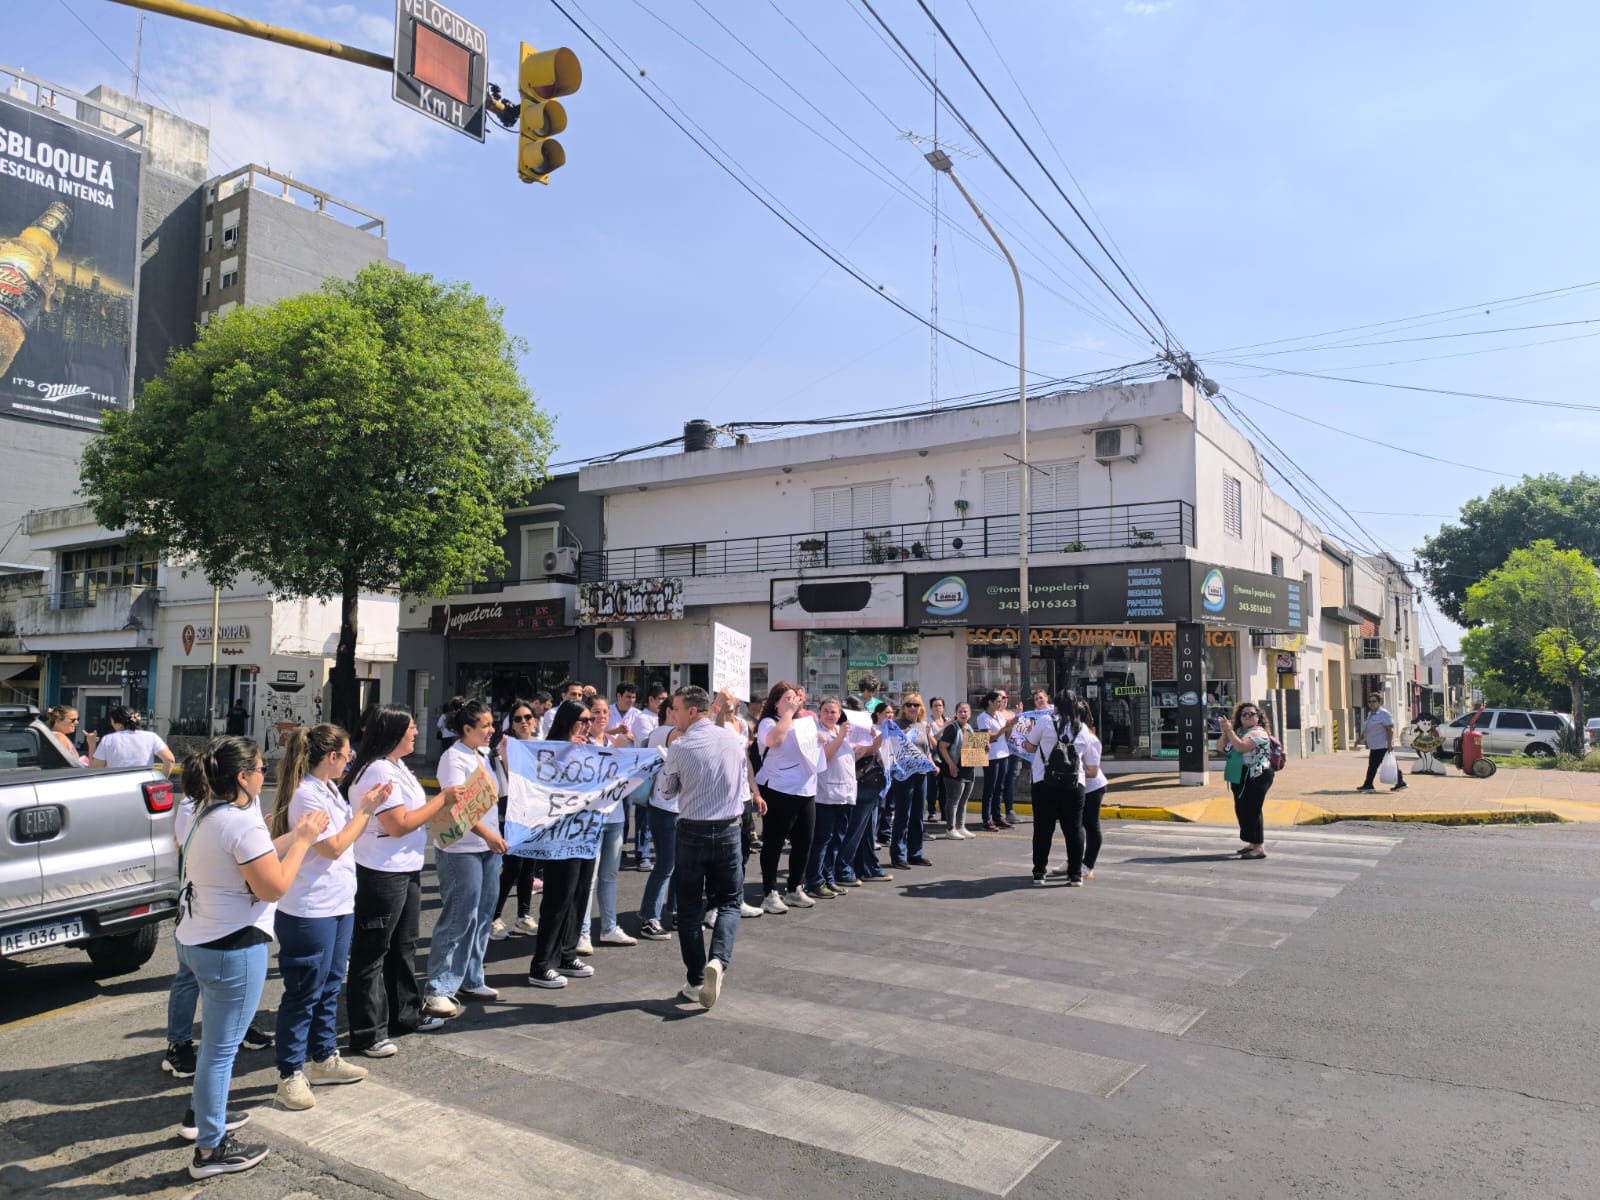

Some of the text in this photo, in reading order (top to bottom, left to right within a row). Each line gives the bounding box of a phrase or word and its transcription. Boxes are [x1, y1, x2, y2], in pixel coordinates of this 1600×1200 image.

[404, 0, 483, 54] VELOCIDAD
[58, 177, 114, 209] INTENSA
[12, 376, 35, 389] IT'S
[37, 382, 91, 402] Miller
[1128, 567, 1162, 576] SELLOS
[986, 583, 1089, 596] @tom1papeleria
[998, 599, 1077, 610] 3435016363
[196, 623, 249, 640] SERNDIPIA
[1117, 686, 1145, 695] ABIERTO
[26, 810, 55, 833] FIAT
[6, 934, 24, 952] AE
[29, 928, 57, 947] 036
[62, 923, 81, 939] TJ
